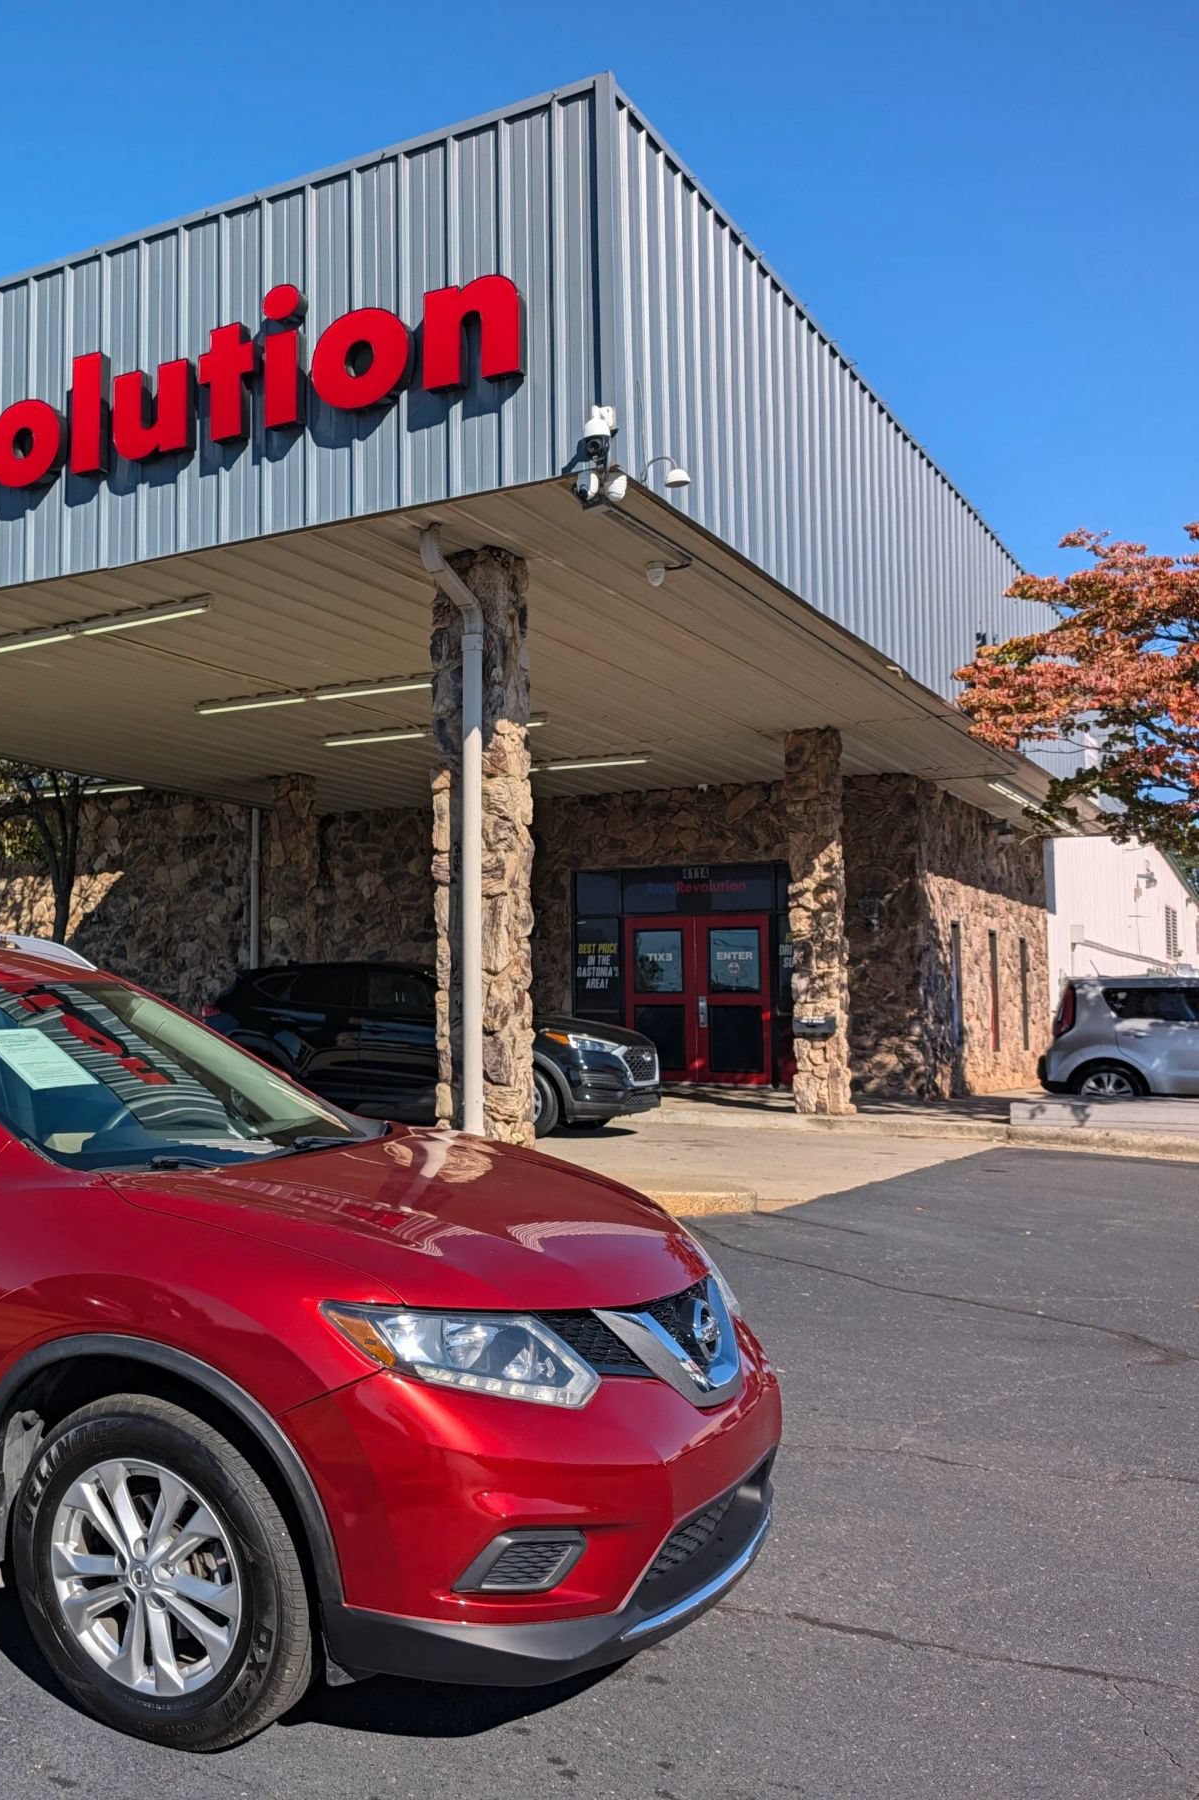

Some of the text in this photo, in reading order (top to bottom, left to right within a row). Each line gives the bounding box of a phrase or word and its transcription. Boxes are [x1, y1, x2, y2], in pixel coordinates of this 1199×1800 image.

[646, 880, 747, 895] AutoRevolution
[578, 943, 618, 954] BEST PRICE
[587, 955, 611, 965] IN THE
[716, 951, 753, 960] ENTER
[585, 978, 609, 989] AREA!
